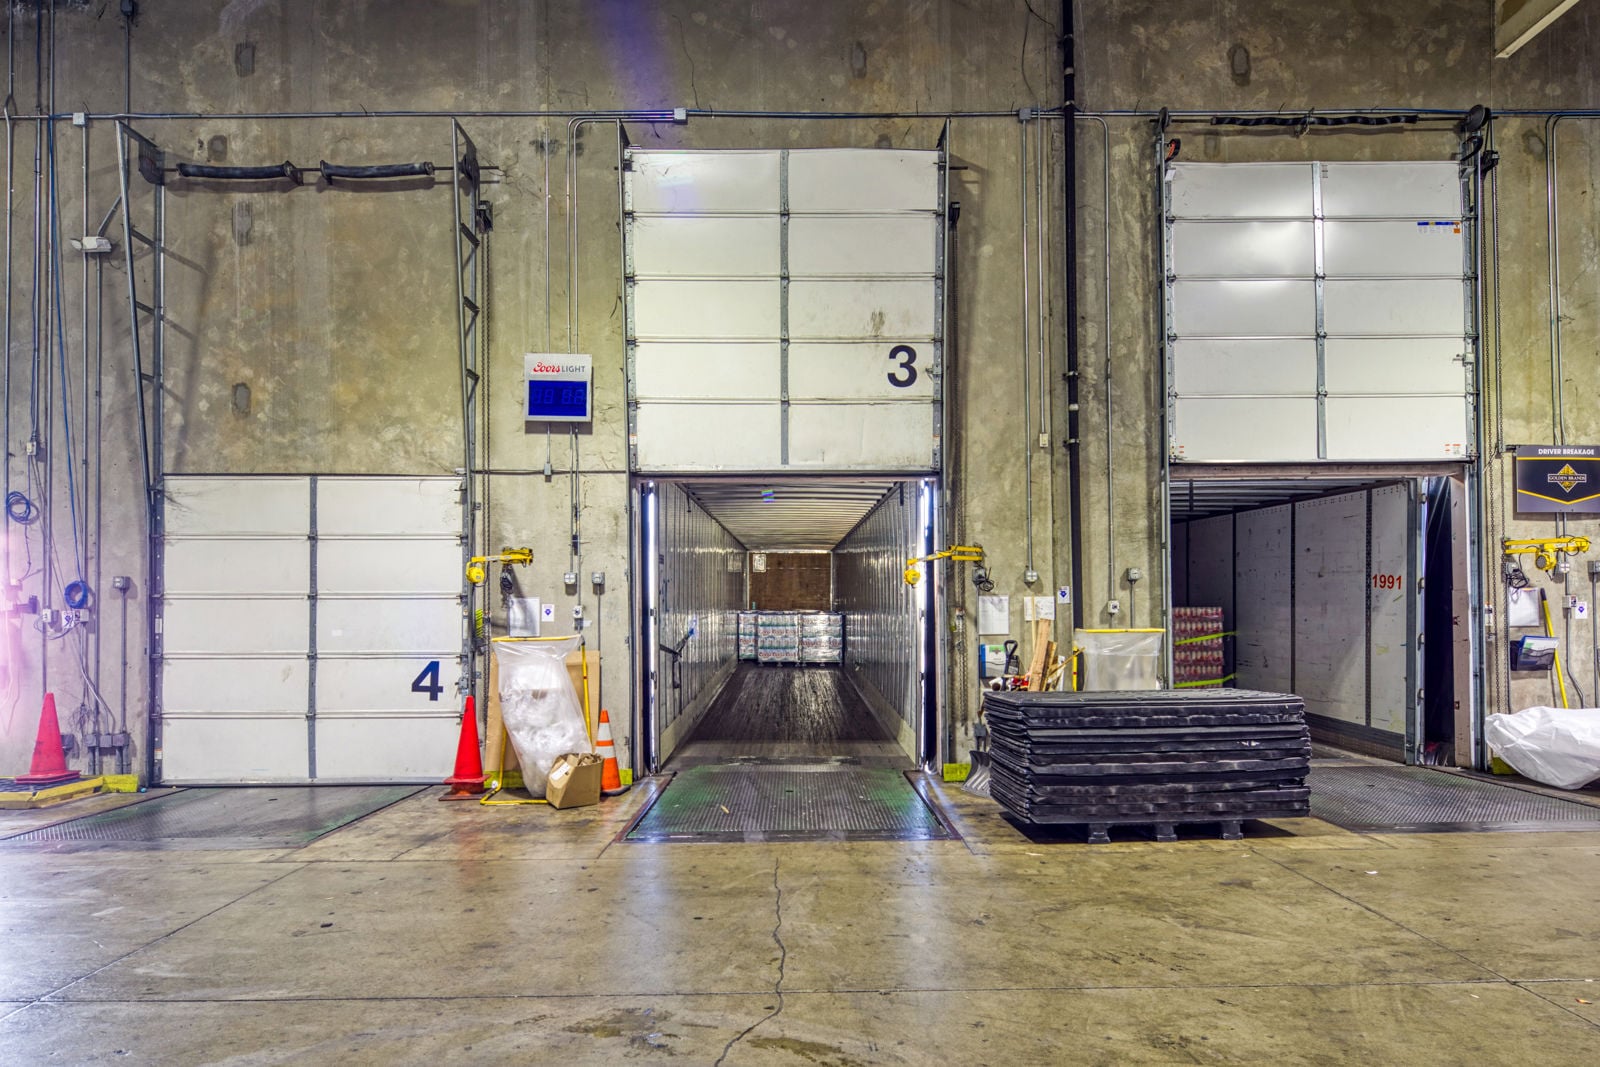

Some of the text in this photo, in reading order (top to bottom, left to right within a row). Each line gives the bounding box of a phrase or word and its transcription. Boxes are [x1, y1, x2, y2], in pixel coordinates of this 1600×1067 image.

[533, 361, 586, 373] Coors LIGHT
[887, 344, 918, 388] 3
[1372, 574, 1402, 590] 1991
[411, 660, 444, 701] 4
